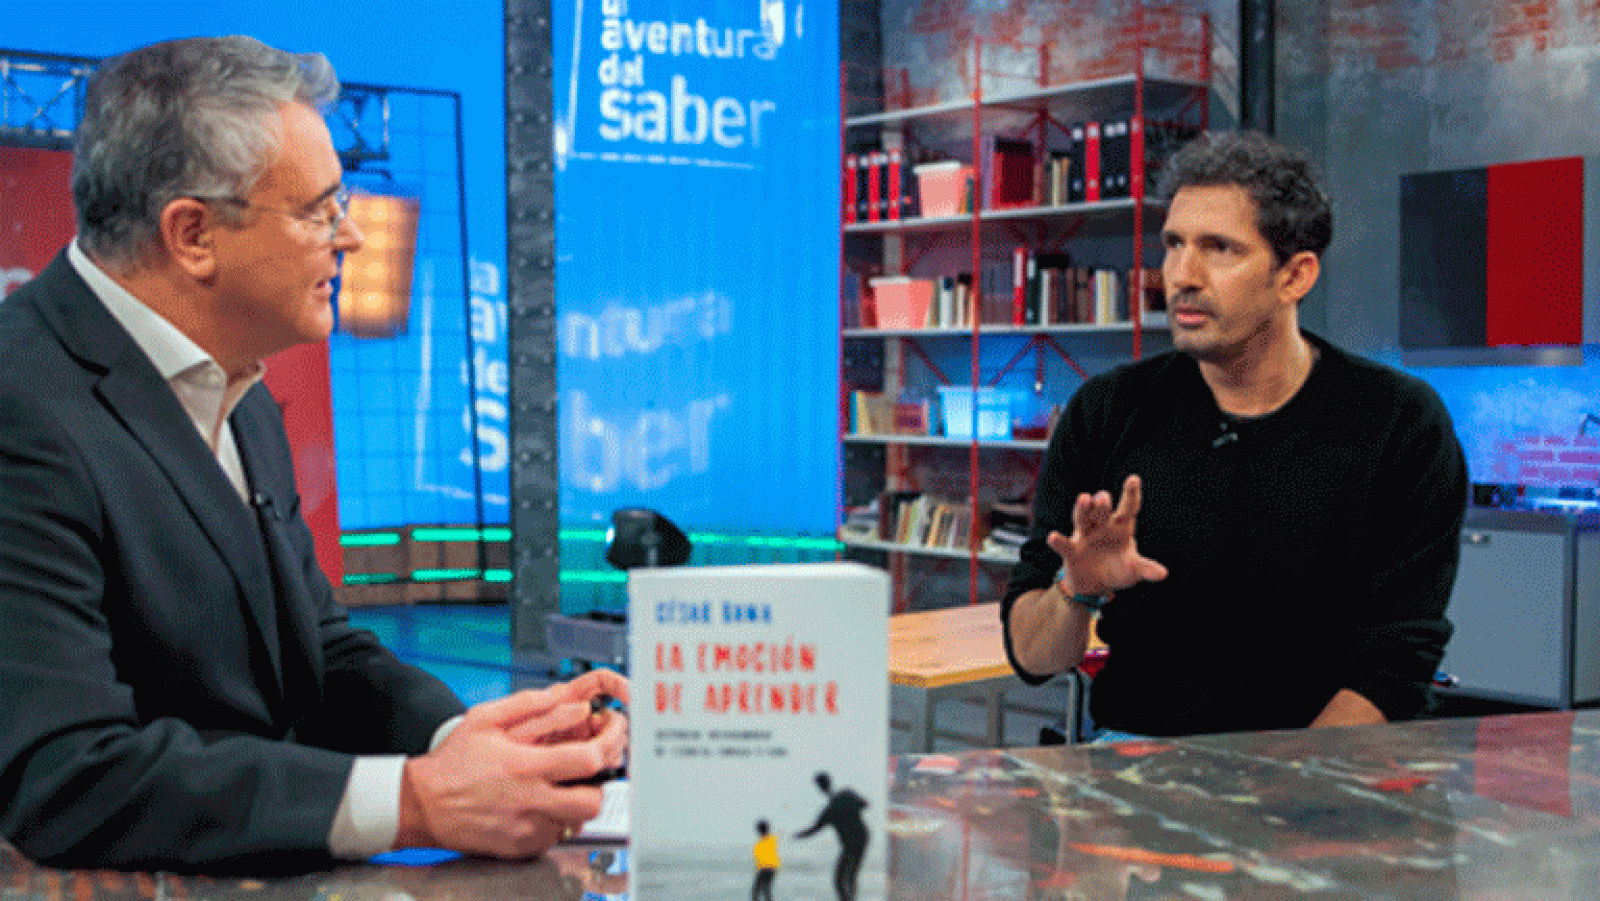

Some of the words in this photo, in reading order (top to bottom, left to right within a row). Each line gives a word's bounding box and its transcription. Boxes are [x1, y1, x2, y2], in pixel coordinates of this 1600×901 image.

[600, 16, 779, 60] aventura
[598, 74, 776, 148] saber
[655, 641, 684, 674] LA
[698, 634, 817, 674] EMOCIÓN
[654, 681, 682, 714] DE
[703, 680, 839, 715] APRENDER
